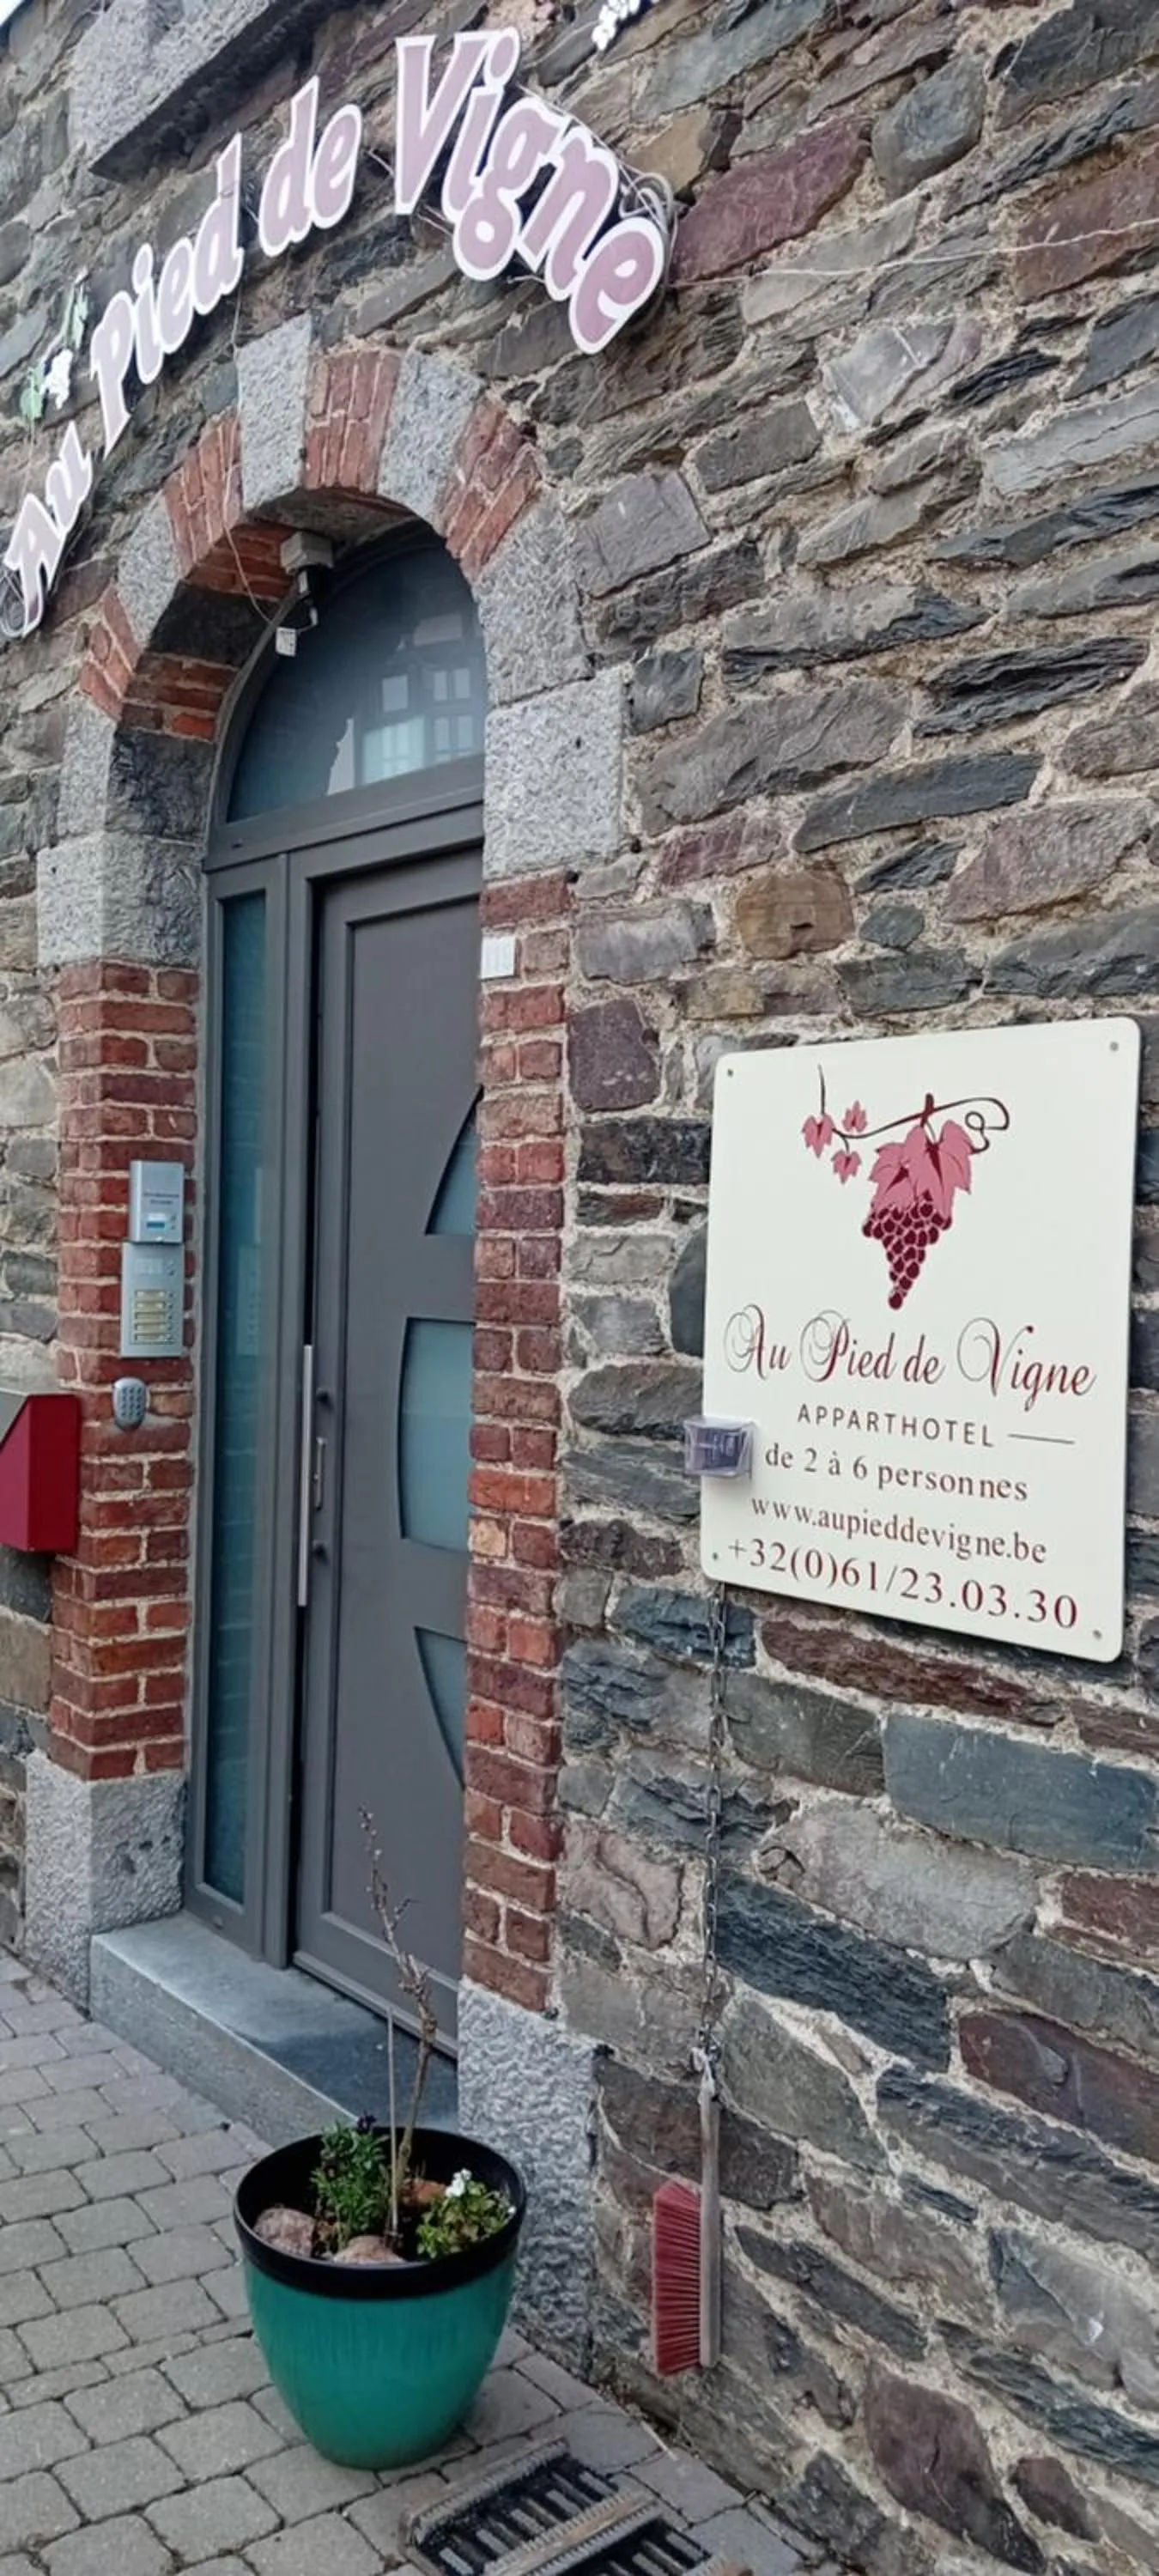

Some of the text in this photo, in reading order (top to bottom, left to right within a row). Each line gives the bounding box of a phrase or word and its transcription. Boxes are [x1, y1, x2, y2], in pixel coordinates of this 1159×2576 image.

[4, 26, 666, 638] Au Pied de Vigne
[724, 1303, 1096, 1411] Au Pied de Vigne
[797, 1403, 995, 1448] APPARTHOTEL
[764, 1443, 1029, 1501] de 2 à 6 personnes
[751, 1496, 1047, 1564] www.aupieddevigne.be
[728, 1537, 1079, 1631] +32(0)61/23.03.30
